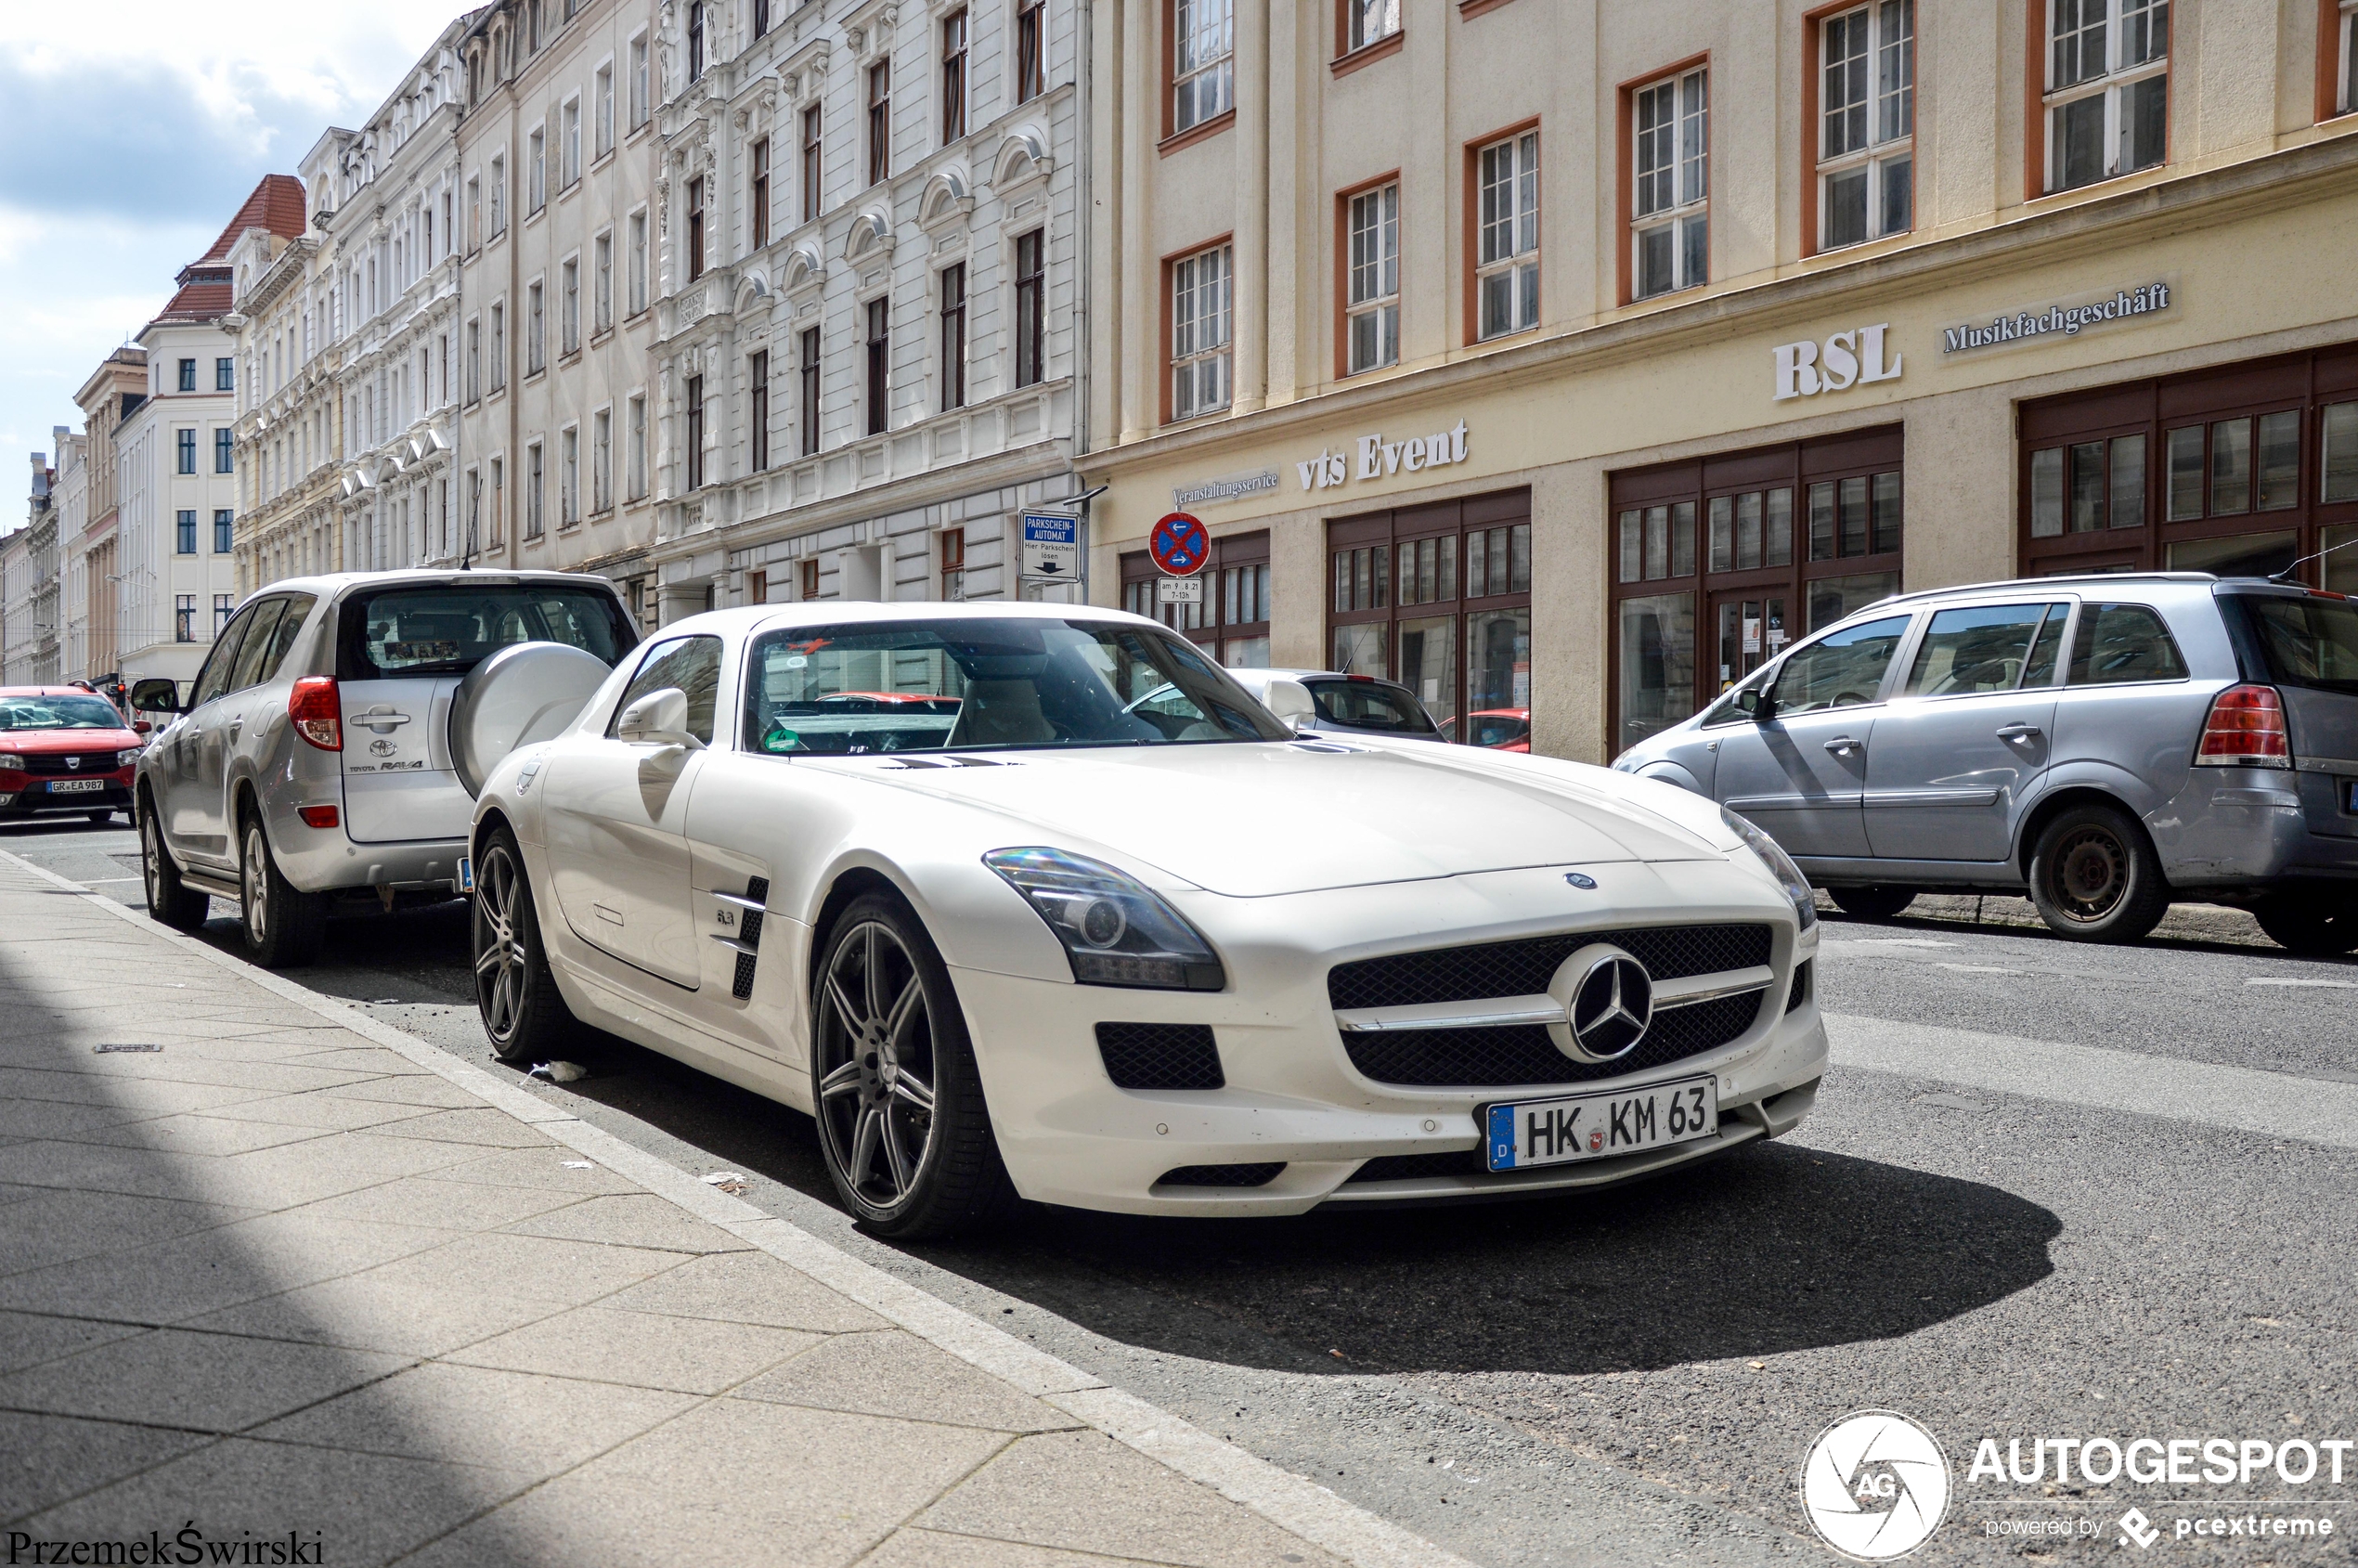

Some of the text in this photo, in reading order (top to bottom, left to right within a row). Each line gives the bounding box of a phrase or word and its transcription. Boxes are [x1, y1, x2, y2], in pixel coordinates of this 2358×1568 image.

[1944, 282, 2170, 353] Musikfachgeschäft
[1772, 322, 1902, 401] RSL
[1296, 418, 1468, 490] vts Event
[1173, 472, 1277, 504] Veranstaltungsservice
[1027, 517, 1073, 531] PARKSCHEIN-
[1033, 529, 1067, 541] AUTOMAT
[1041, 543, 1075, 552] Parkschein
[1041, 551, 1058, 560] lösen
[380, 759, 423, 771] RAV4
[53, 780, 103, 791] GR EA 987
[1497, 1086, 1706, 1159] D HK KM 63
